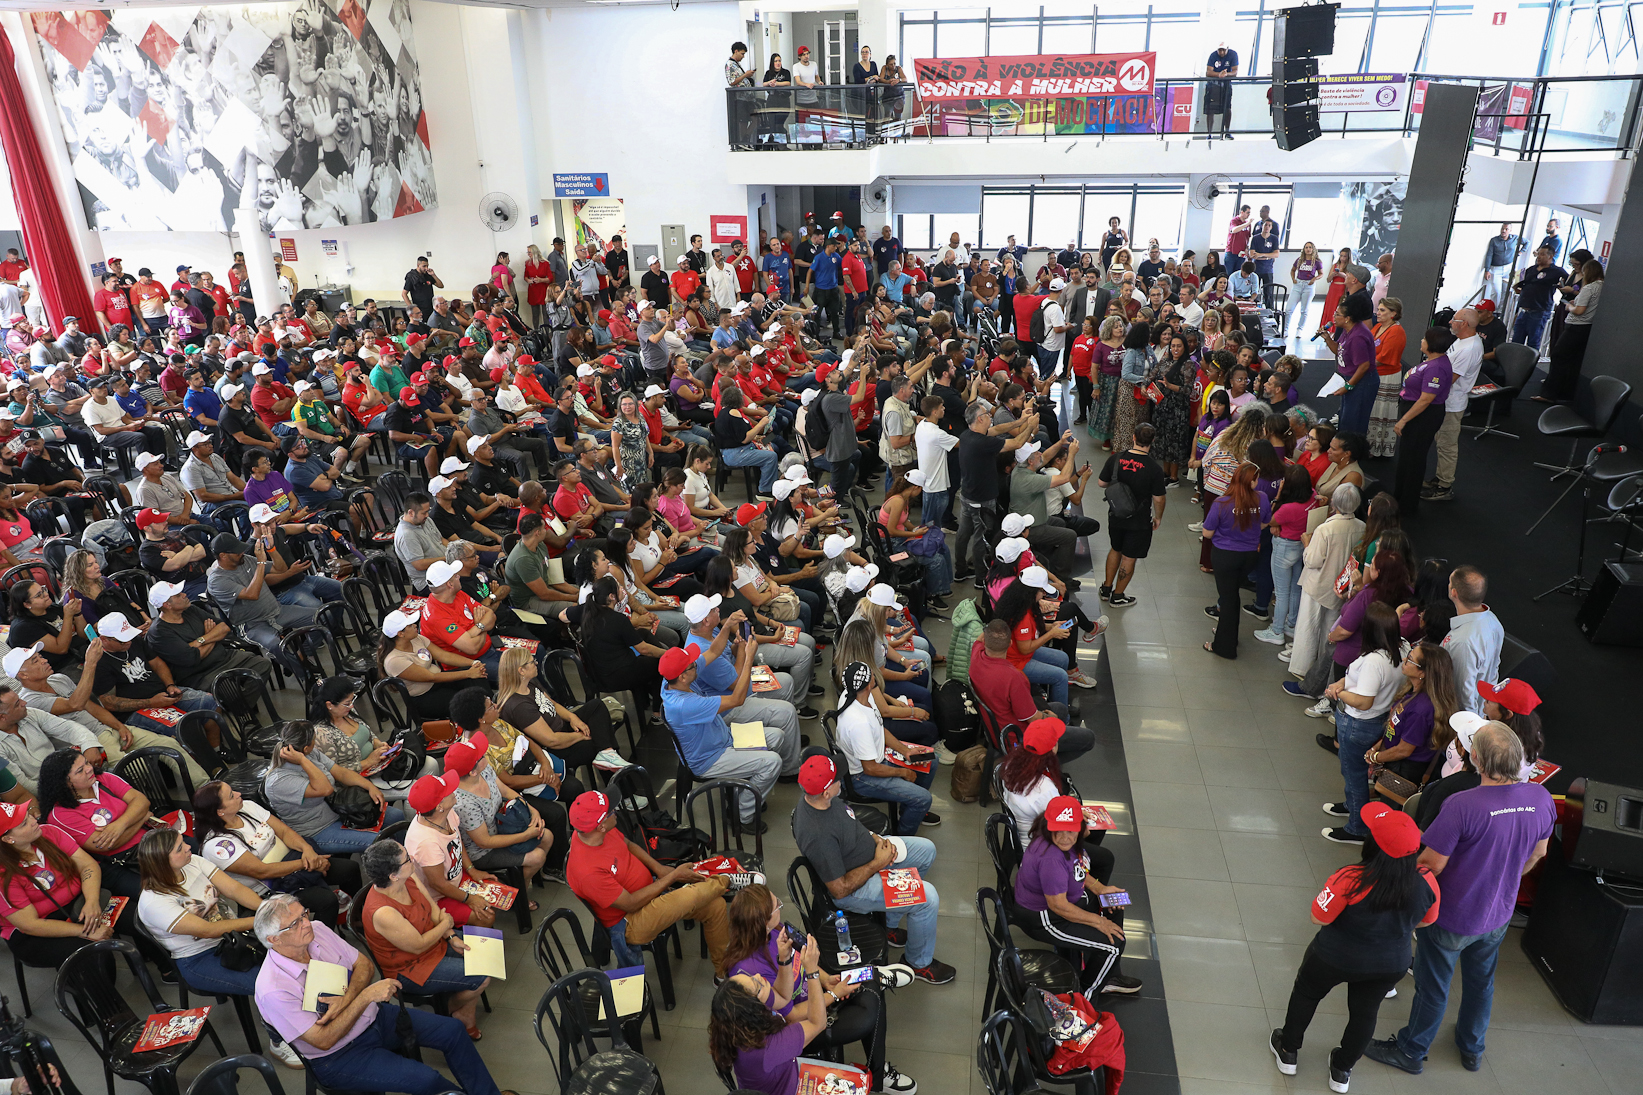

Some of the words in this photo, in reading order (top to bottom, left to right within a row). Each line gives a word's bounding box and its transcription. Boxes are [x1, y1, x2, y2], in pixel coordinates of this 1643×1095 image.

[920, 60, 966, 81] NÃO
[973, 58, 988, 80] À
[999, 57, 1117, 79] VIOLÊNCIA
[920, 80, 1001, 97] CONTRA
[1008, 79, 1023, 95] A
[1029, 77, 1116, 95] MULHER
[1029, 98, 1155, 125] DEMOCRACIA
[1490, 808, 1516, 816] Bancários
